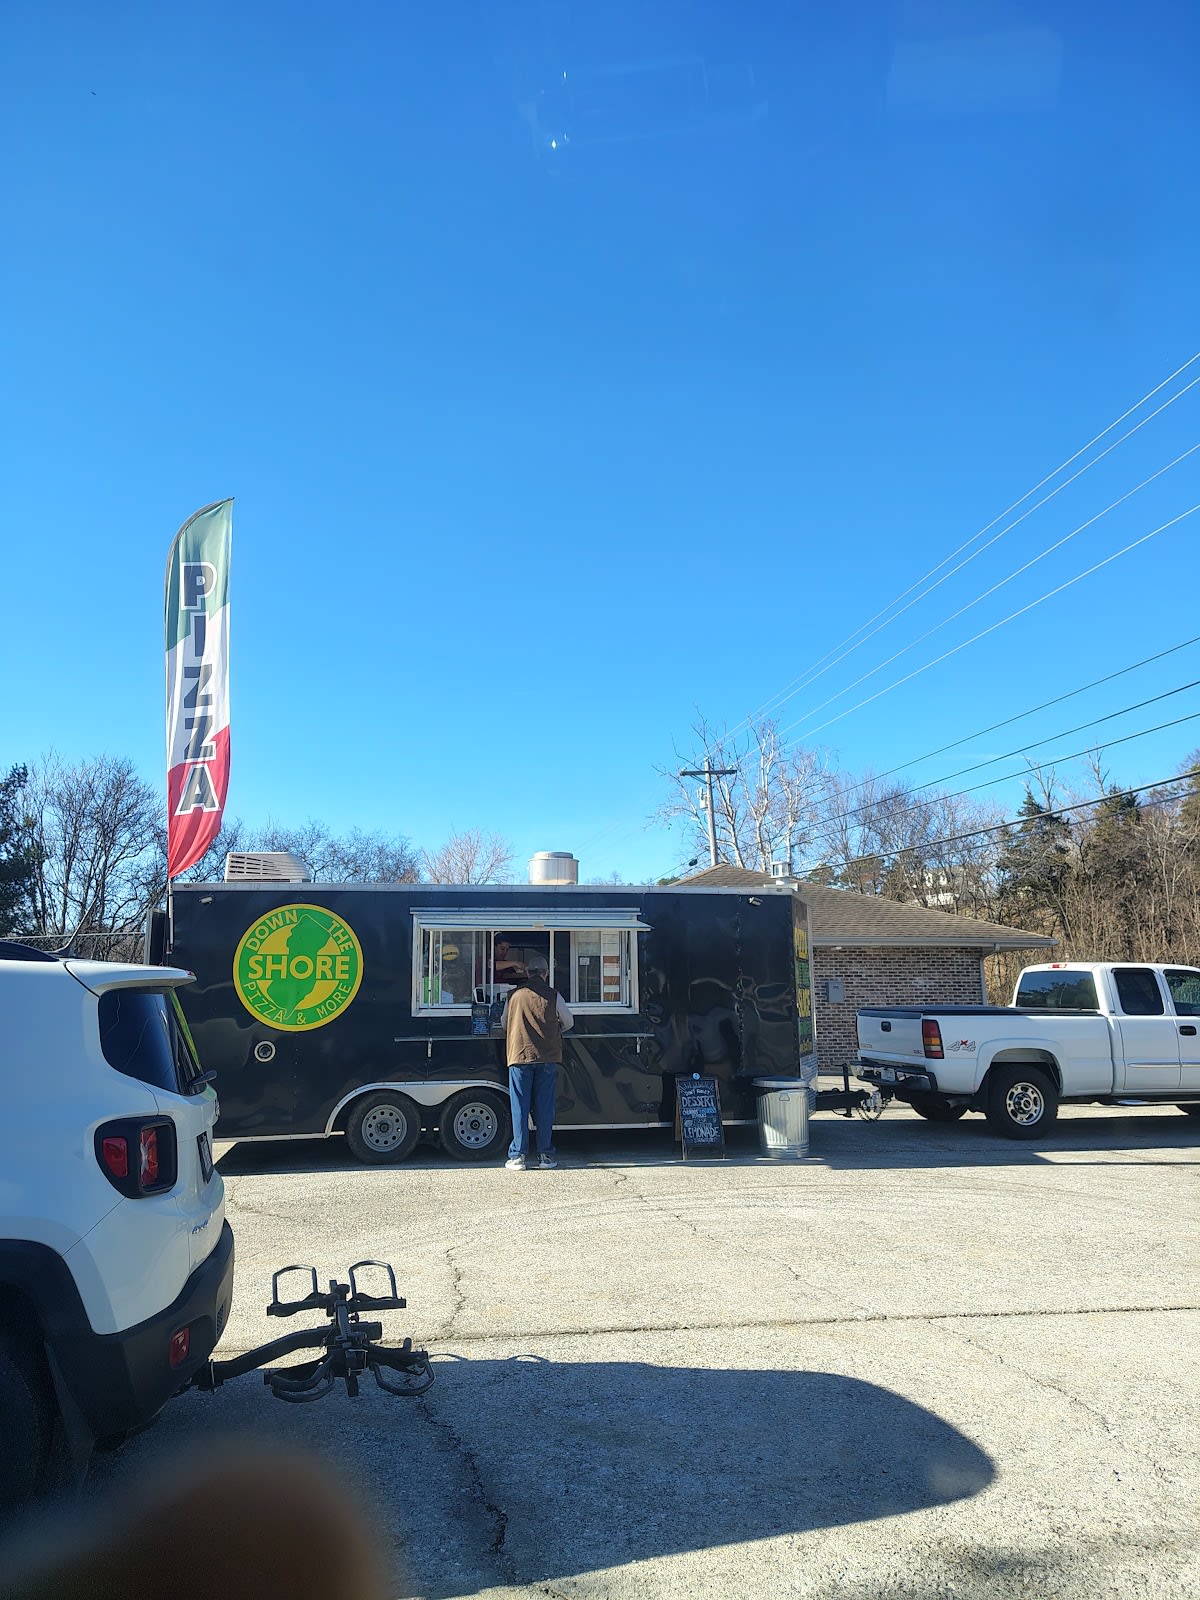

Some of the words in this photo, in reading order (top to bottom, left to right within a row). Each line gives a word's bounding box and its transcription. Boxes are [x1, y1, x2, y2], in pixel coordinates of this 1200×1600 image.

[175, 562, 220, 815] PIZZA
[245, 909, 298, 952] DOWN
[328, 920, 354, 953] THE
[248, 955, 350, 980] SHORE
[243, 981, 285, 1022] PIZZA
[296, 1012, 306, 1024] &
[316, 983, 352, 1018] MORE
[682, 1095, 715, 1108] DESSERT
[684, 1127, 720, 1138] LEMONADE
